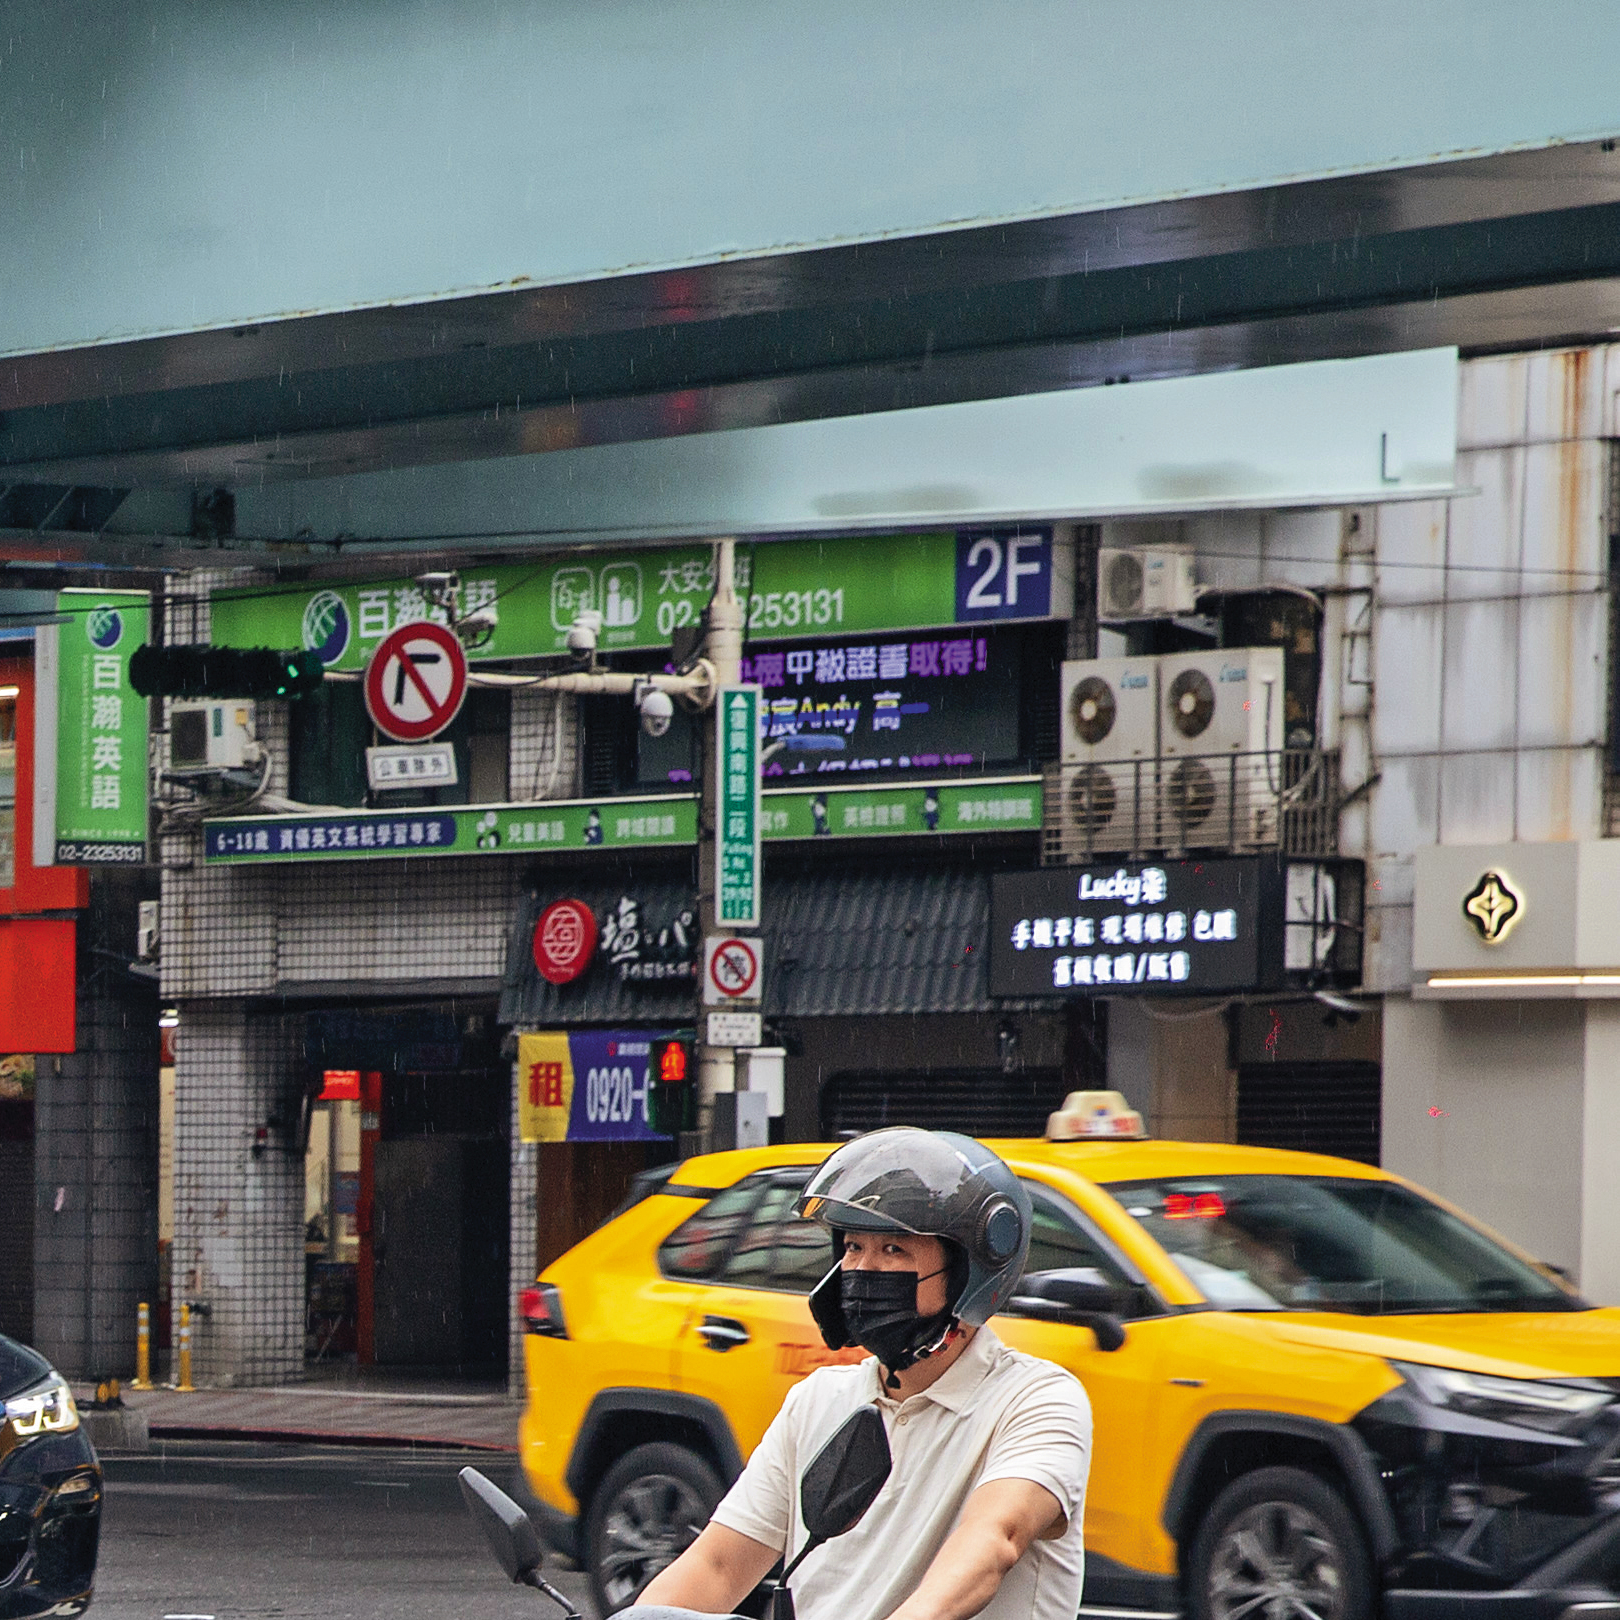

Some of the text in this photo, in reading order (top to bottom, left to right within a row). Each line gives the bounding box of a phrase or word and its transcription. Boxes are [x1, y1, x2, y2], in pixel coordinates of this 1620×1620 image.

[965, 534, 1043, 609] 2F
[91, 655, 122, 810] 百瀚英語
[58, 844, 142, 862] 02-23253131
[216, 830, 269, 851] 6-18歲
[529, 1061, 564, 1108] 租
[586, 1067, 650, 1123] 0920-
